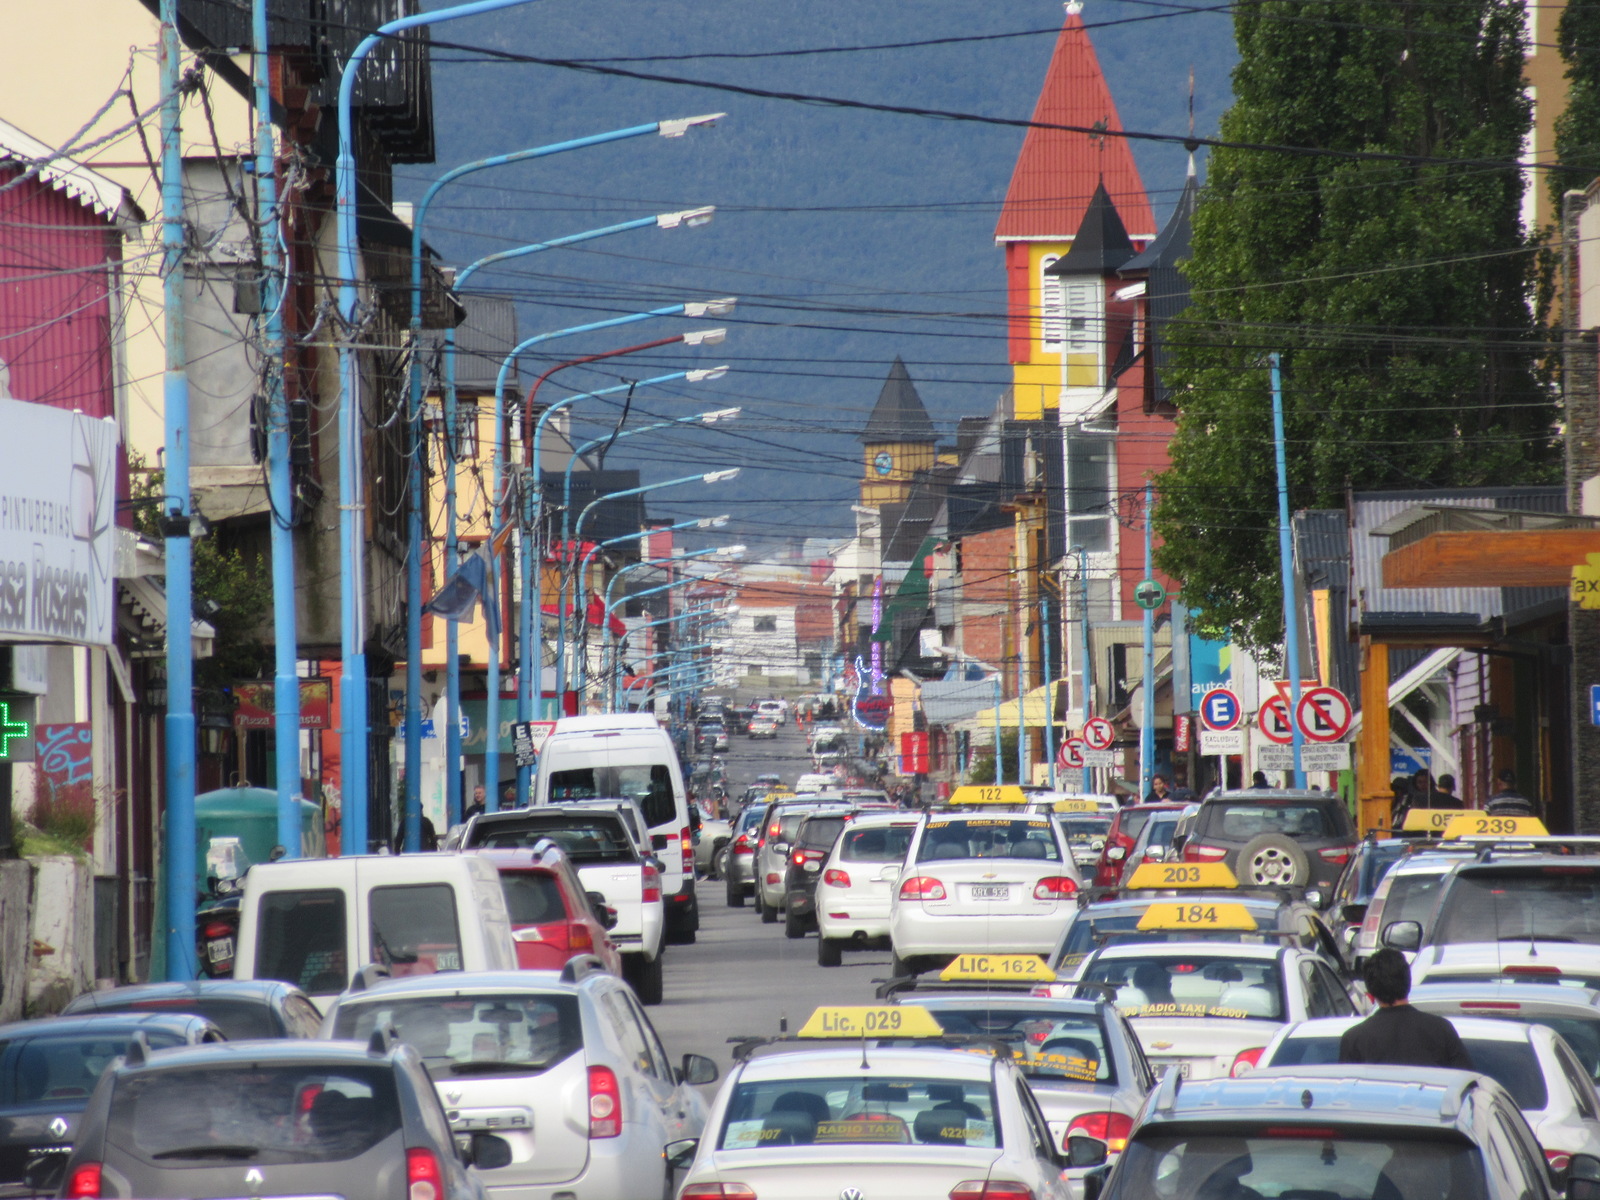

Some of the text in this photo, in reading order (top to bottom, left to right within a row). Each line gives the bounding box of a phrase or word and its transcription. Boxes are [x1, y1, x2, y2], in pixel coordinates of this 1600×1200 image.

[2, 495, 70, 539] PINTURERIAS
[31, 542, 89, 639] Rosales
[1212, 698, 1230, 722] E
[239, 715, 270, 725] Pizza
[516, 725, 527, 739] E
[979, 788, 1001, 800] 122
[1068, 801, 1087, 810] 169
[1476, 819, 1517, 834] 239
[1163, 867, 1200, 882] 203
[991, 887, 1009, 898] 935
[1176, 906, 1218, 922] 184
[959, 958, 1037, 973] LIC. 162
[1140, 1003, 1177, 1013] RADIO
[1180, 1004, 1207, 1013] TAXI
[1209, 1006, 1249, 1019] 422007
[822, 1011, 902, 1032] Lic. 029
[1034, 1051, 1098, 1071] TAXI
[817, 1125, 900, 1134] RADIO TAXI
